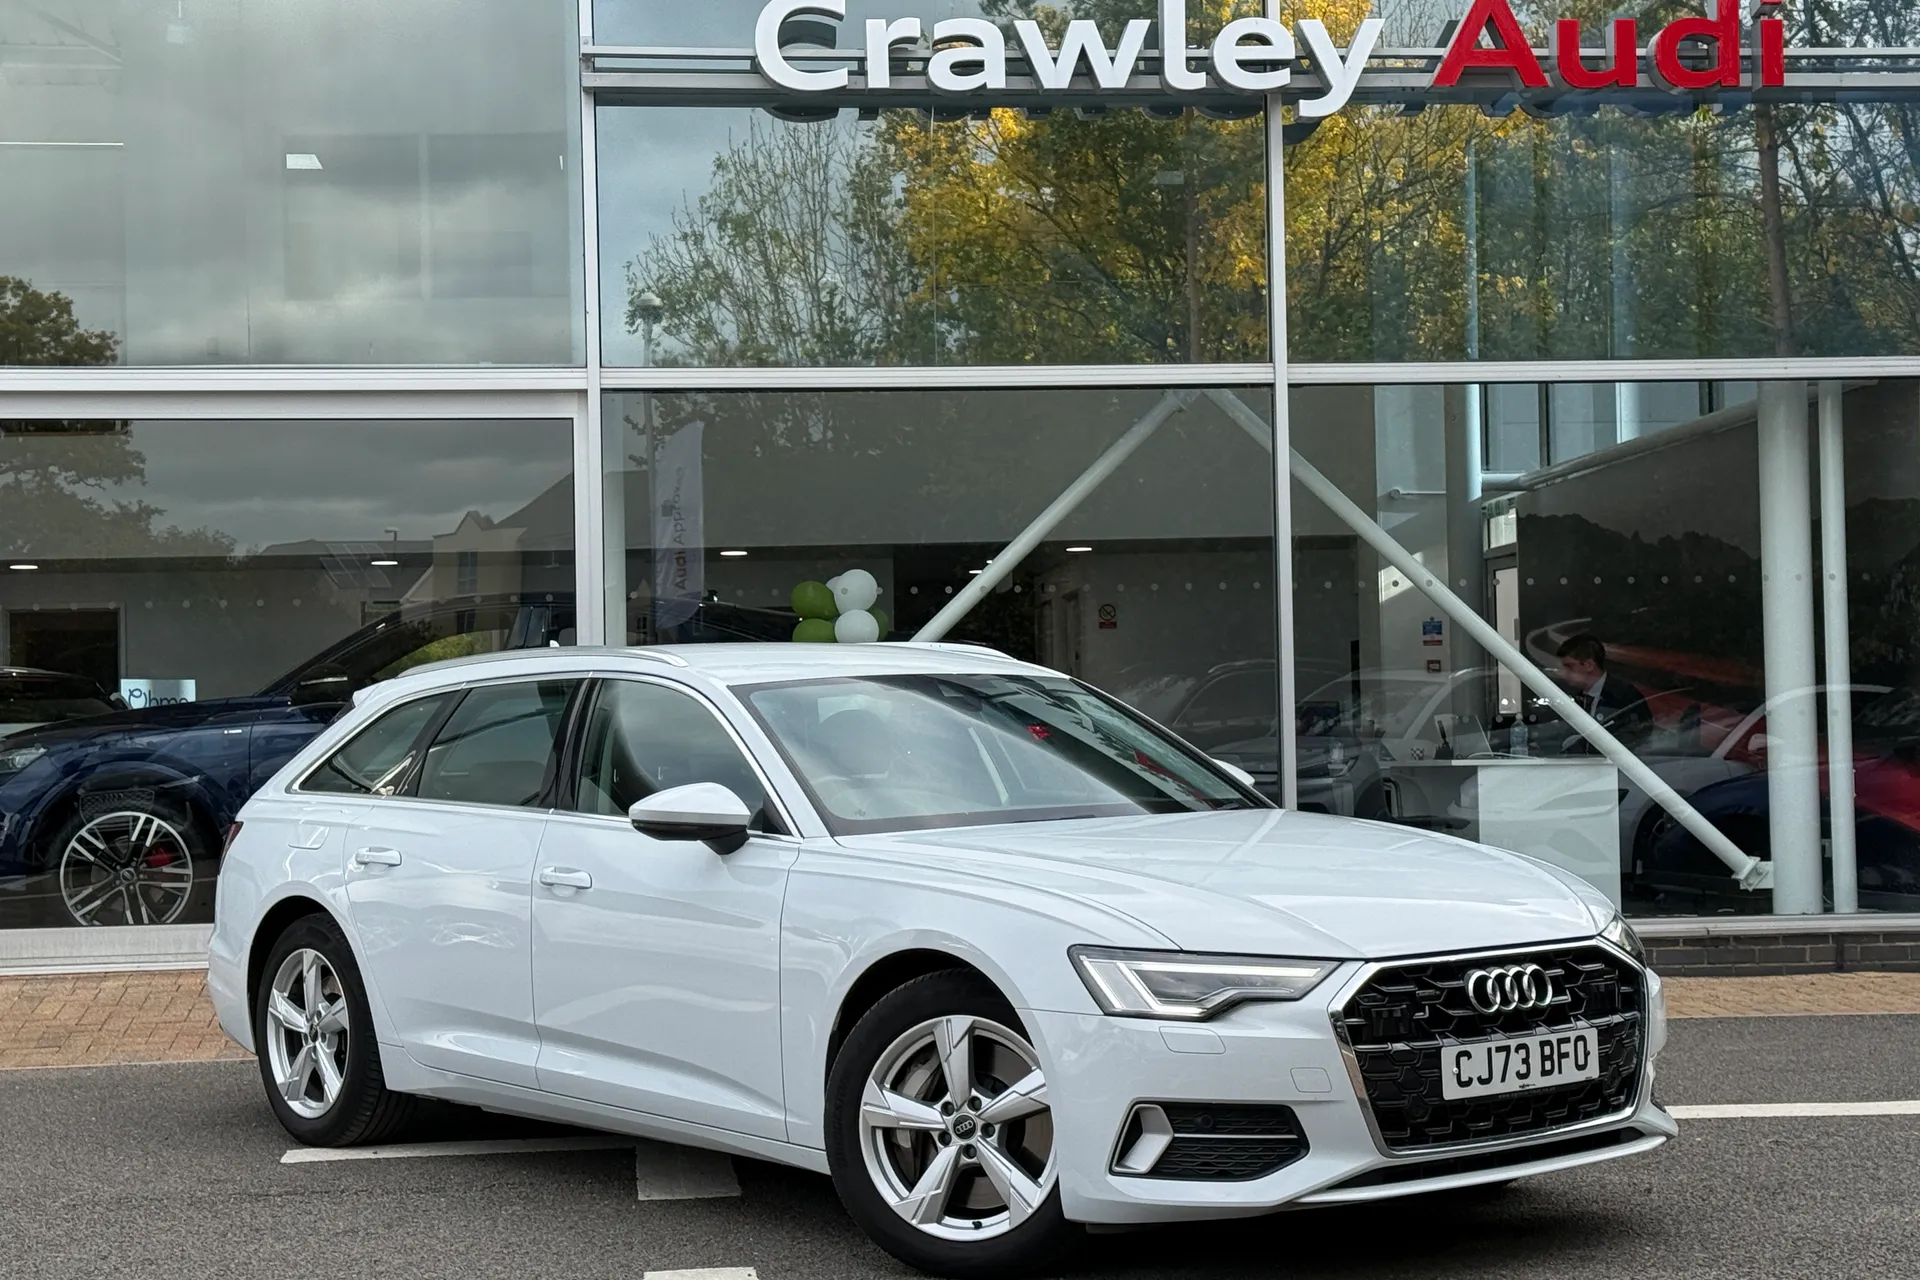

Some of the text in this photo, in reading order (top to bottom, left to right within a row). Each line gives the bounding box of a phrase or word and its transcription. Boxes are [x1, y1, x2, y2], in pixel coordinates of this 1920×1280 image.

[755, 0, 1785, 117] Crawley Audi
[674, 551, 687, 590] Audi
[1455, 1035, 1589, 1088] CJ73 BFO
